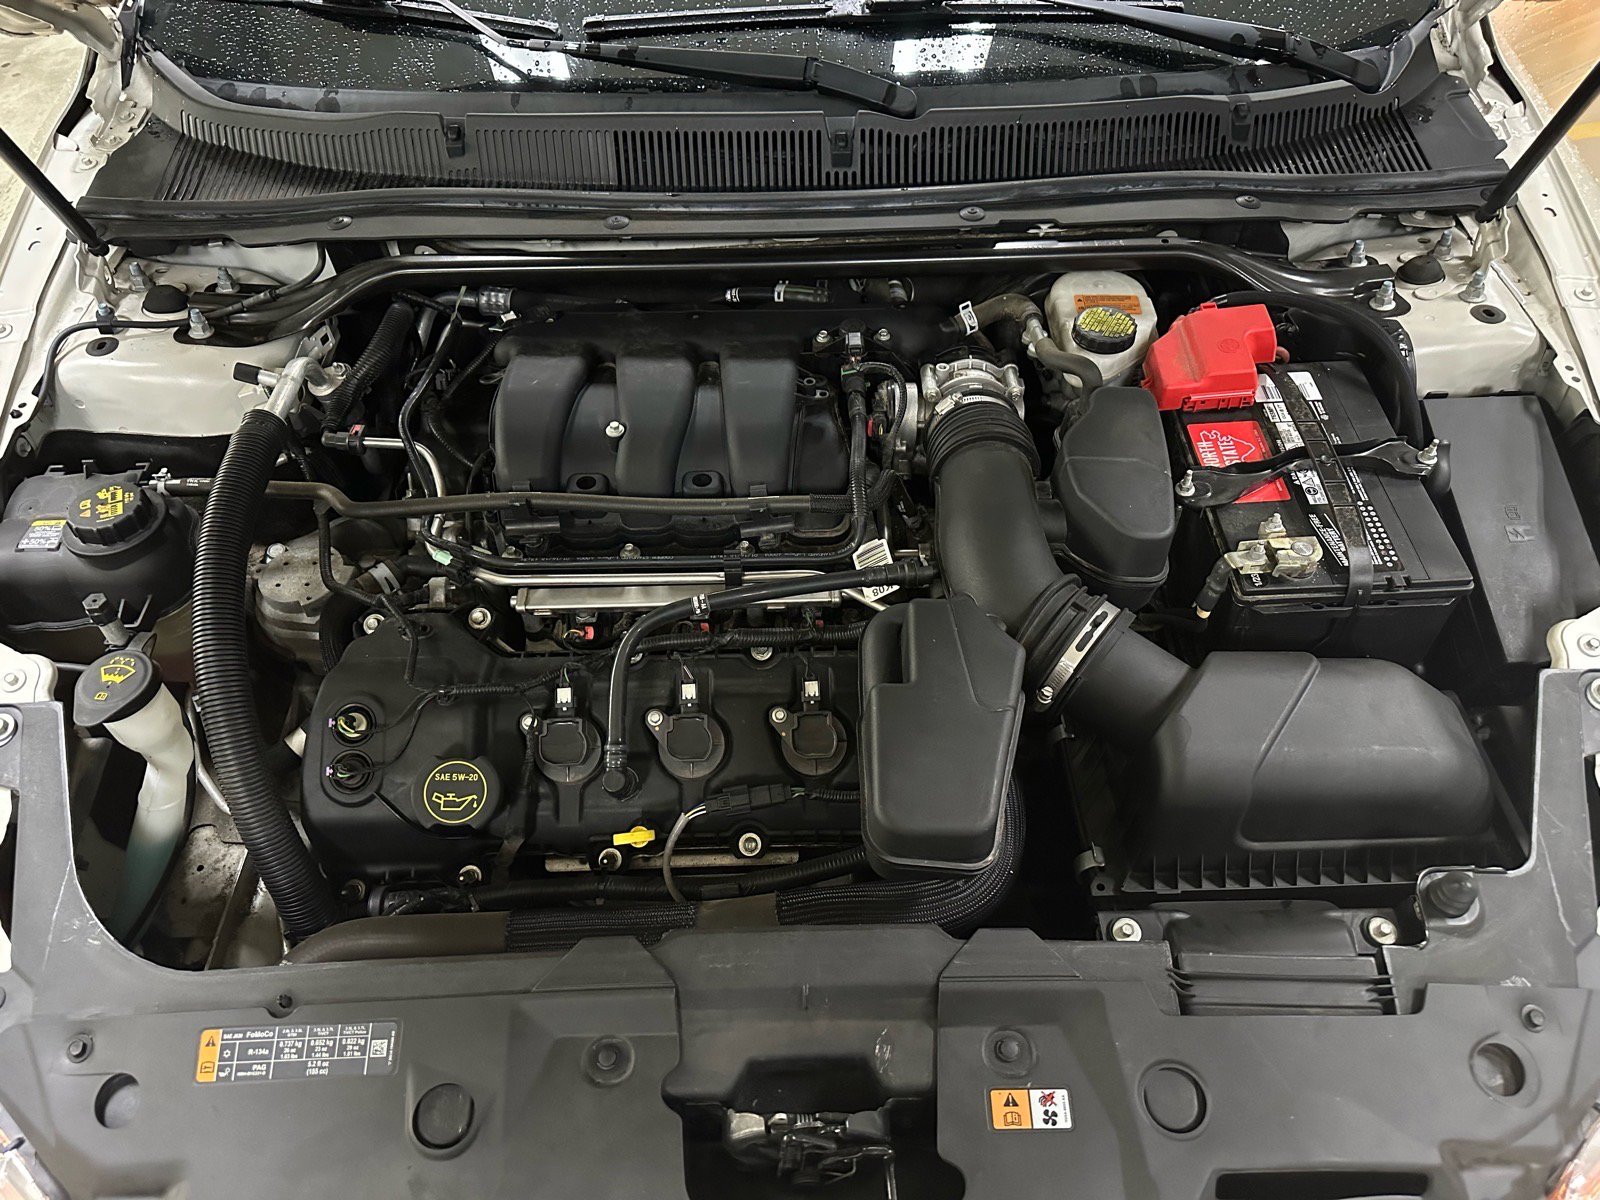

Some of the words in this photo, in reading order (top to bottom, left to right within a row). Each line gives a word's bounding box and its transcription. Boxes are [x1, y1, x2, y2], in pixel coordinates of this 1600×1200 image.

[1309, 513, 1349, 566] MAINTENANCE-FREE
[435, 773, 450, 781] SAE
[452, 773, 479, 781] 5W-20
[246, 1030, 274, 1038] FoMoCo
[279, 1040, 295, 1048] 0.737
[295, 1039, 303, 1048] kg
[326, 1038, 334, 1047] kg
[357, 1037, 365, 1046] kg
[247, 1048, 269, 1056] R-134a
